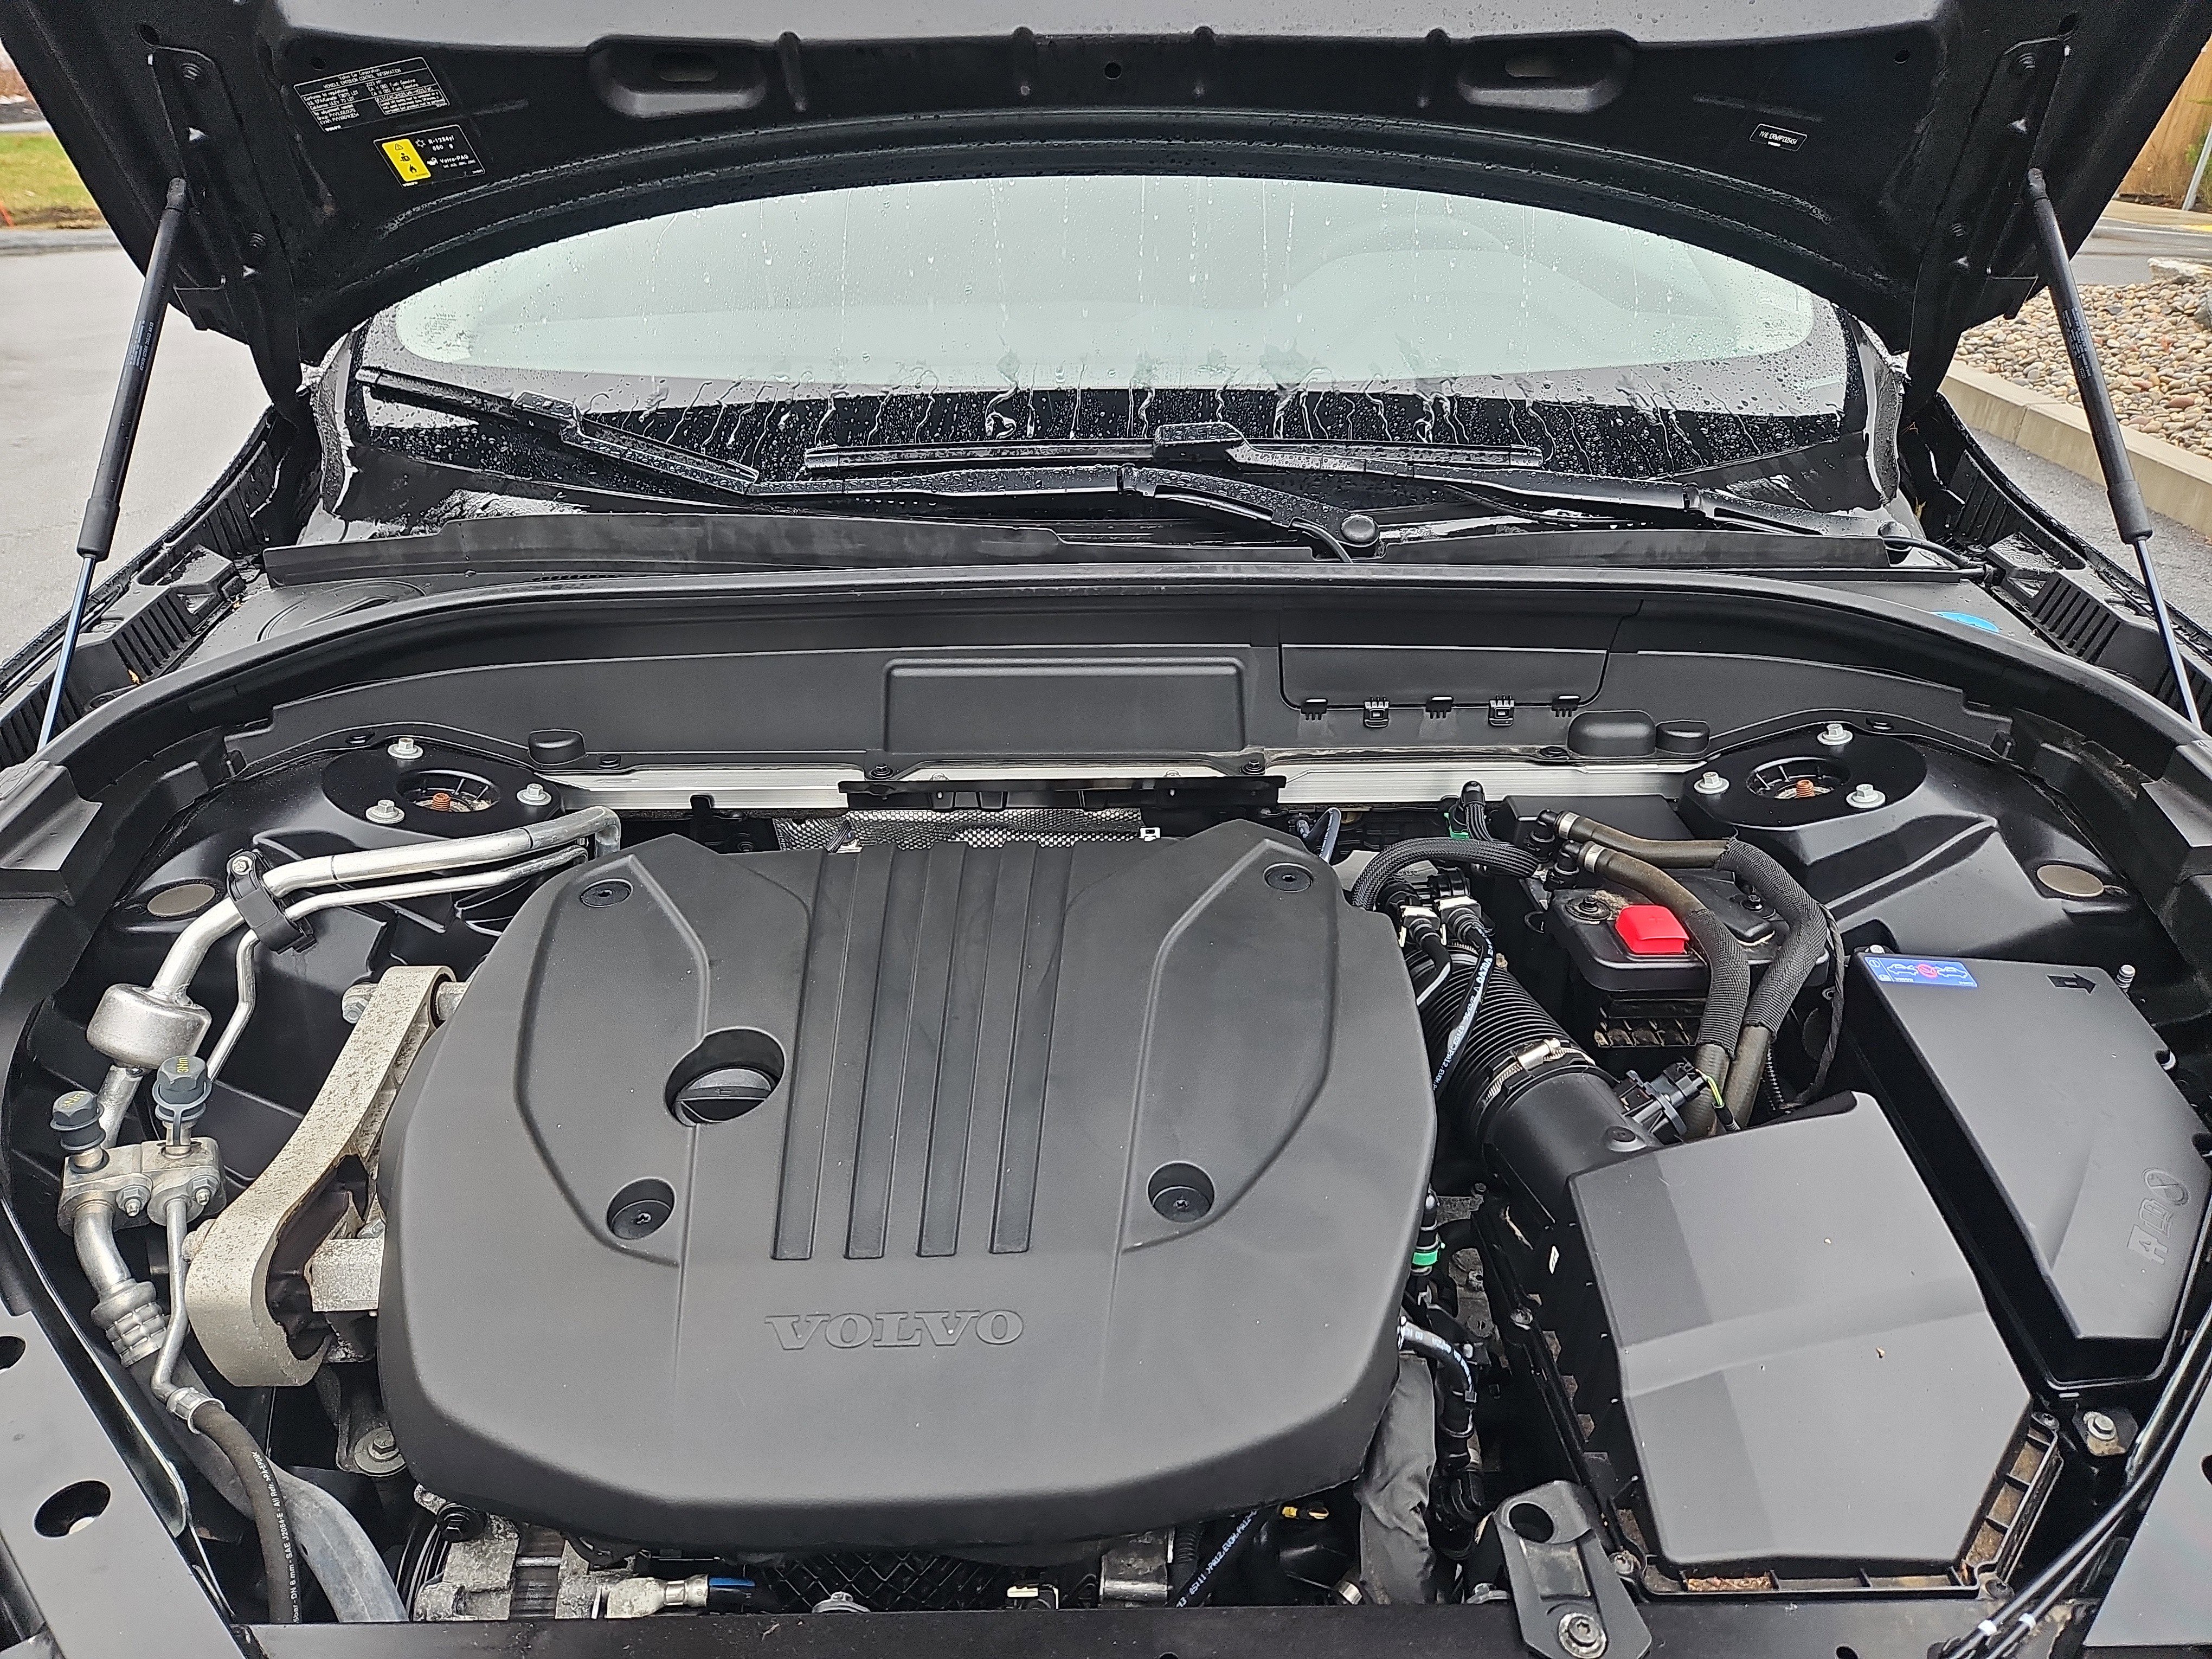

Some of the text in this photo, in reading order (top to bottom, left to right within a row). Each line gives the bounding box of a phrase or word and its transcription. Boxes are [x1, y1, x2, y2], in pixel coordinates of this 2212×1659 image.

[1476, 957, 1493, 983] VOLVO
[176, 1057, 189, 1073] 3Nm
[764, 1309, 1024, 1351] VOLVO
[272, 1497, 281, 1507] All
[284, 1541, 293, 1559] SAE
[288, 1563, 295, 1579] mm
[290, 1586, 298, 1600] DN
